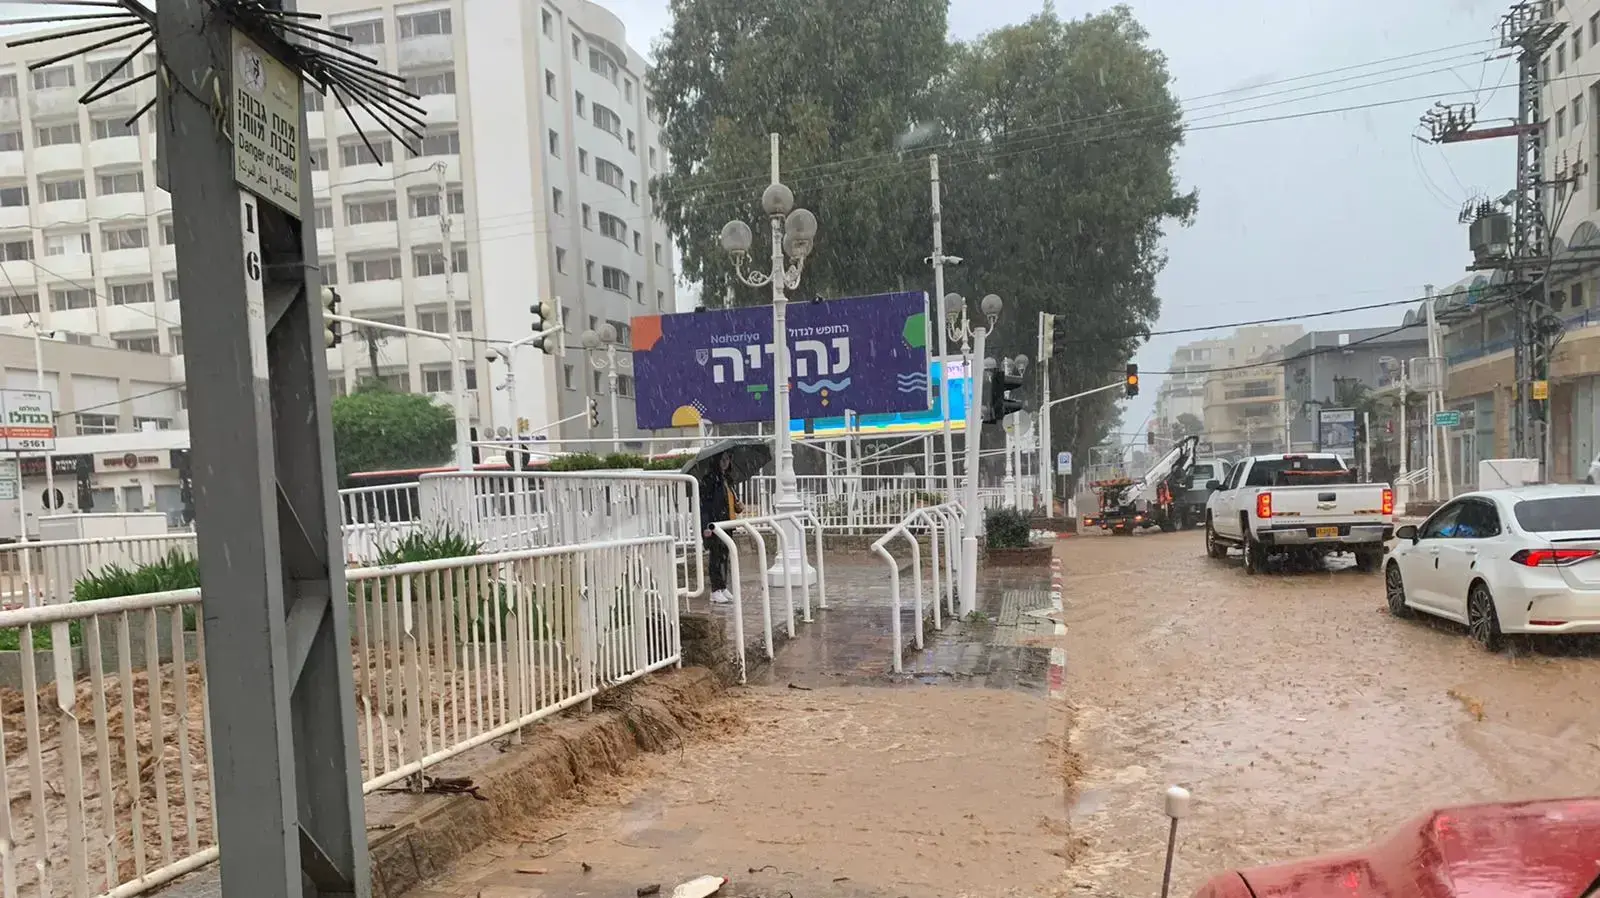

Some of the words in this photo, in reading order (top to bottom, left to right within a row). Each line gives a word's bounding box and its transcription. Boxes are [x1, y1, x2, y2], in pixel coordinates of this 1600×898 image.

[238, 88, 267, 124] גבוה!
[238, 109, 265, 142] מוות!
[272, 112, 295, 143] מתח
[238, 131, 265, 162] Danger
[266, 153, 274, 168] of
[274, 156, 297, 184] Death!
[270, 131, 296, 162] סכנת
[710, 332, 760, 344] Nahariya
[788, 326, 814, 337] לגדול
[815, 324, 850, 335] החופש
[712, 337, 851, 383] נהריה
